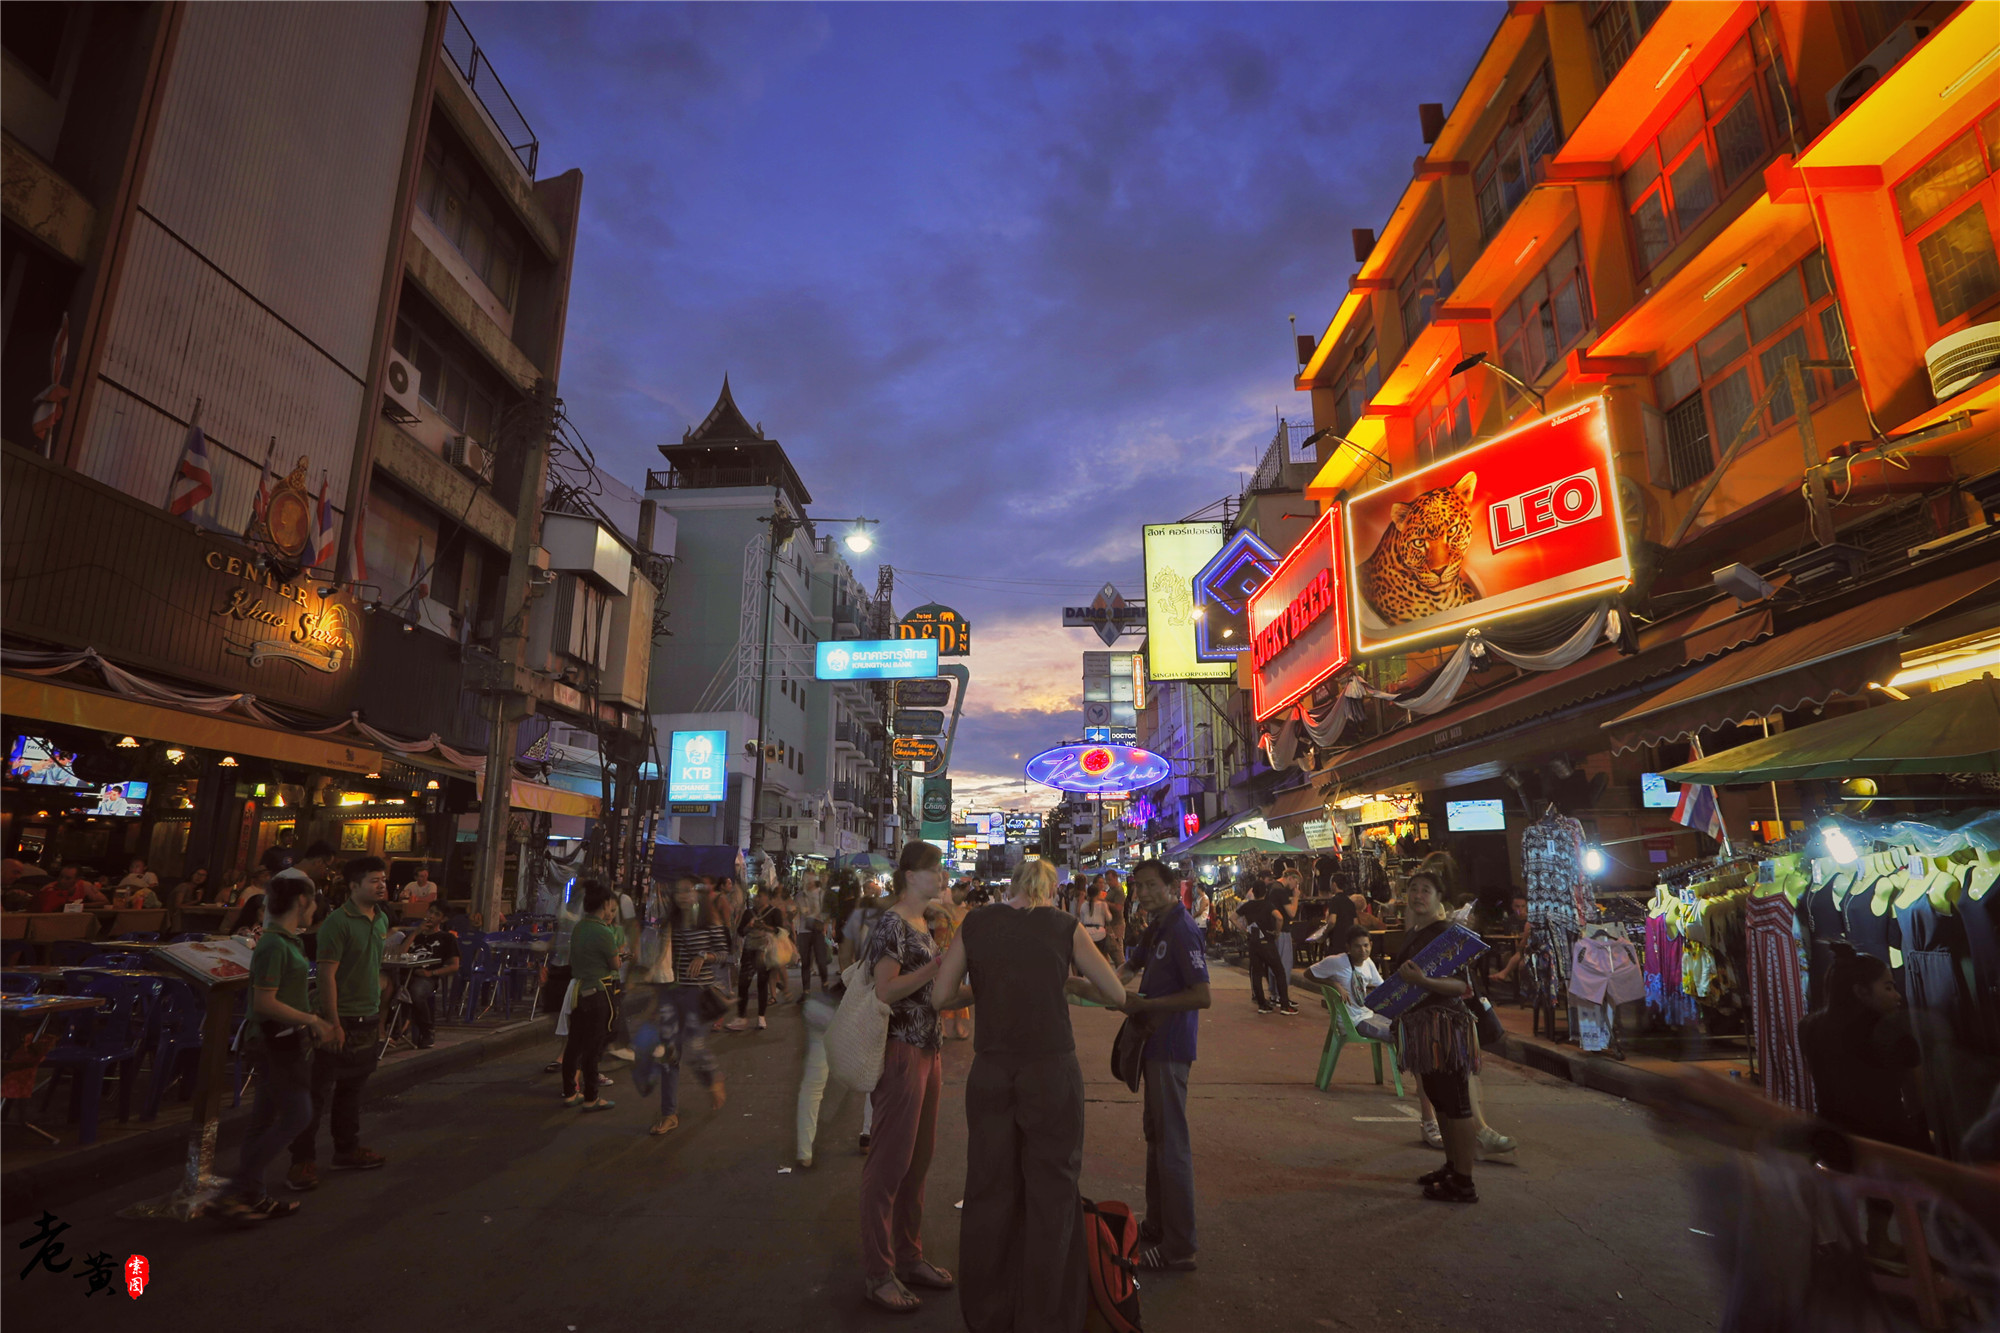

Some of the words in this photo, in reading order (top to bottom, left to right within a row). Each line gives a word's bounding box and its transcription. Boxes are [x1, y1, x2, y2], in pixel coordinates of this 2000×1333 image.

[1493, 476, 1597, 546] LEO
[206, 551, 309, 608] CENTER
[216, 587, 288, 627] Khao
[291, 612, 346, 648] Sarn
[1065, 607, 1107, 619] DANG
[1252, 608, 1290, 674] LUCKY
[1289, 568, 1332, 640] BEER
[959, 623, 968, 652] INN
[1216, 643, 1239, 652] Street
[852, 648, 928, 662] ธนาคารกรุงไทย
[852, 661, 892, 669] KRUNGTHAI
[909, 741, 936, 751] Massage
[682, 767, 712, 780] KTB
[1042, 753, 1086, 783] The
[1102, 762, 1160, 782] Club
[924, 801, 947, 811] Chang
